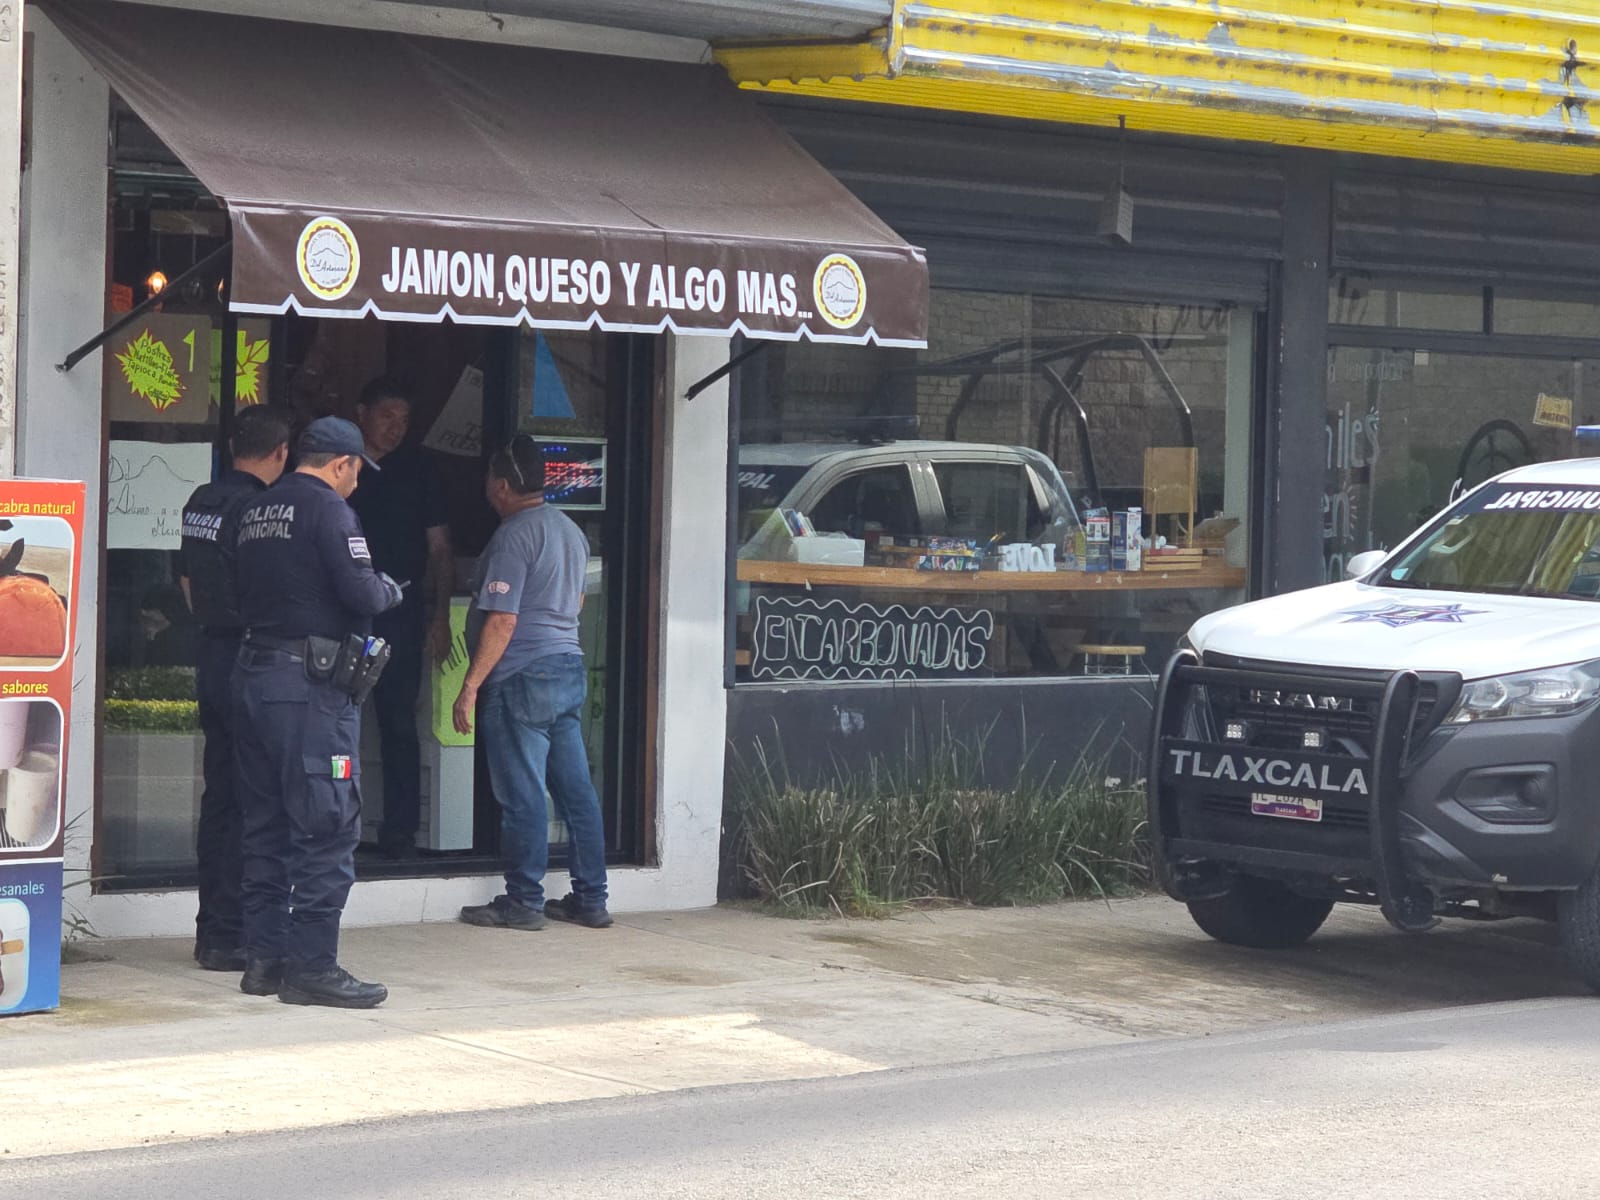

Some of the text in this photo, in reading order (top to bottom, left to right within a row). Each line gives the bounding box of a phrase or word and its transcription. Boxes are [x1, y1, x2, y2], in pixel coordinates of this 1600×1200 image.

[619, 262, 640, 306] Y
[647, 264, 726, 313] ALGO
[33, 500, 75, 514] natural
[2, 680, 48, 693] sabores
[1170, 749, 1368, 794] TLAXCALA
[0, 881, 45, 896] sanales
